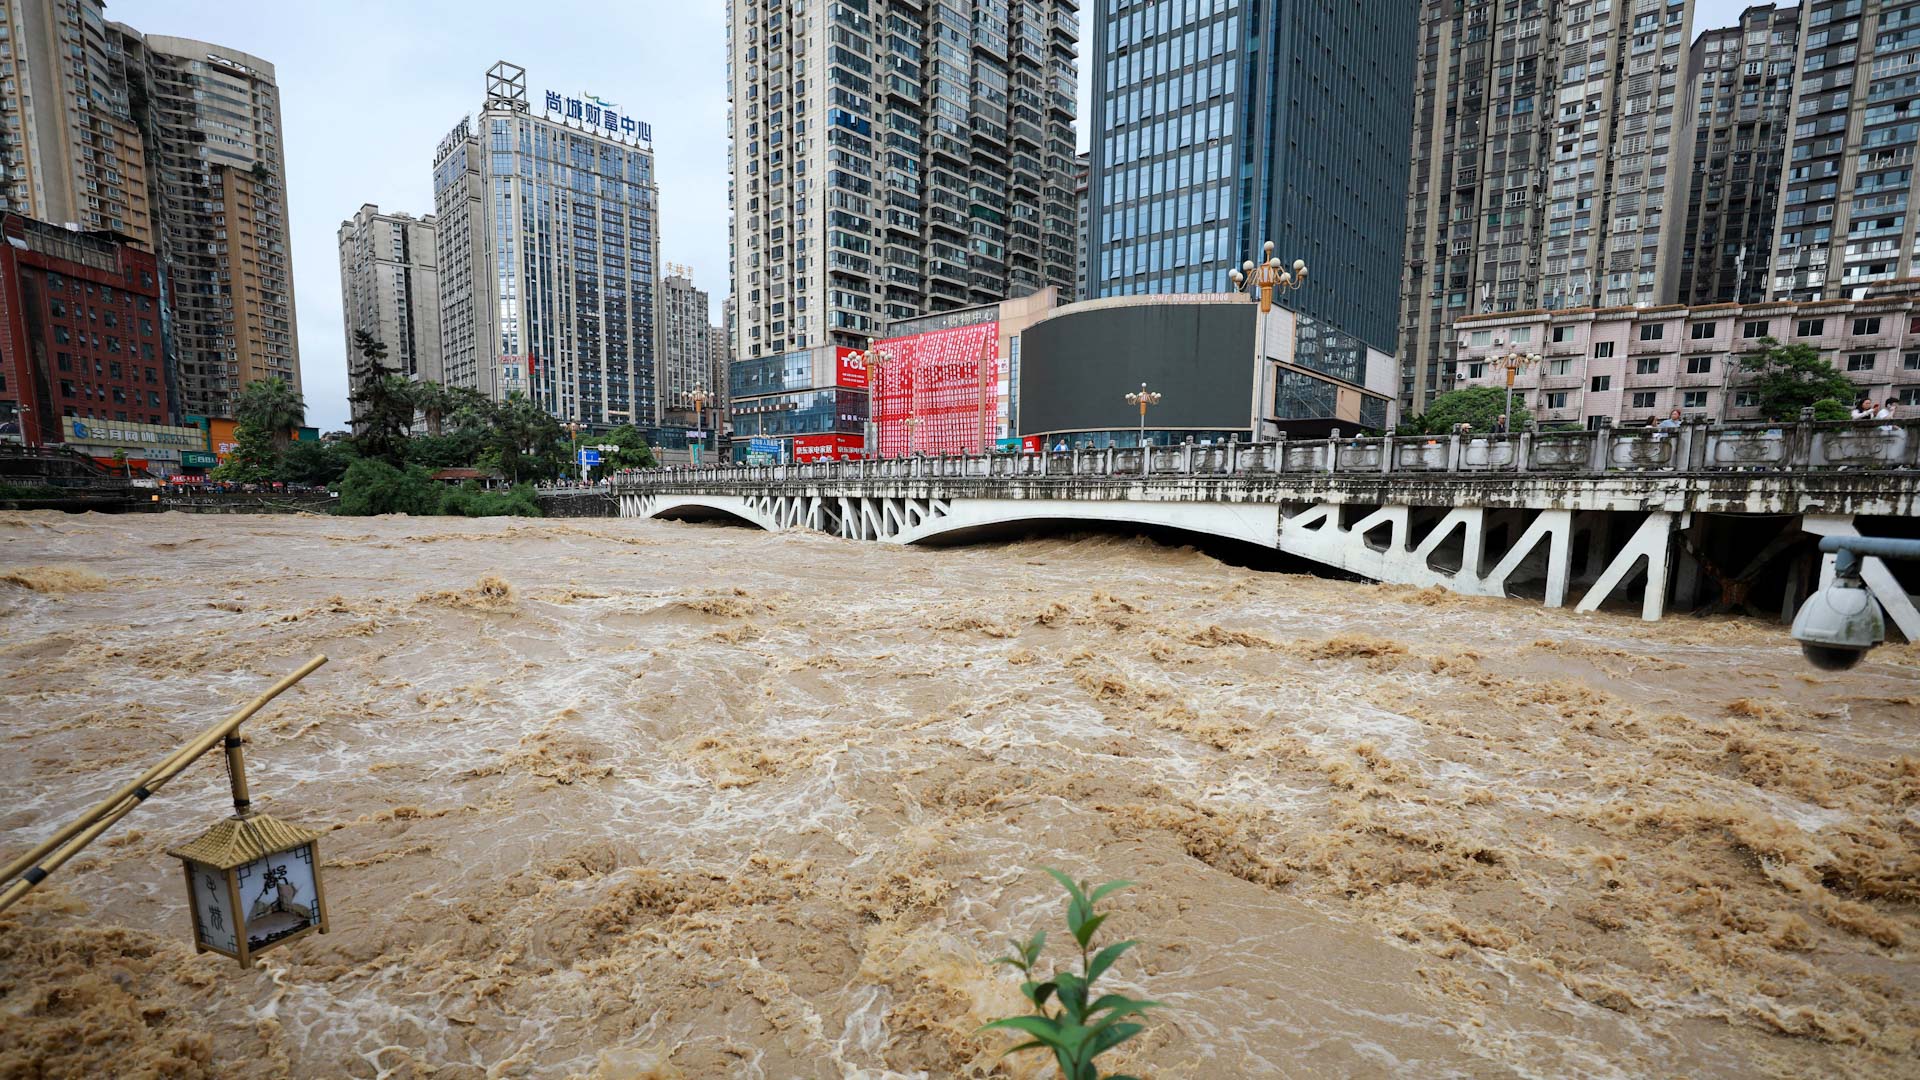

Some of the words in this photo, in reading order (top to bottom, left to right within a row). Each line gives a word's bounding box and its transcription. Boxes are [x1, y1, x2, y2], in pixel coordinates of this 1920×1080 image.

[545, 89, 652, 142] 尚城财富中心
[841, 356, 867, 371] TCL
